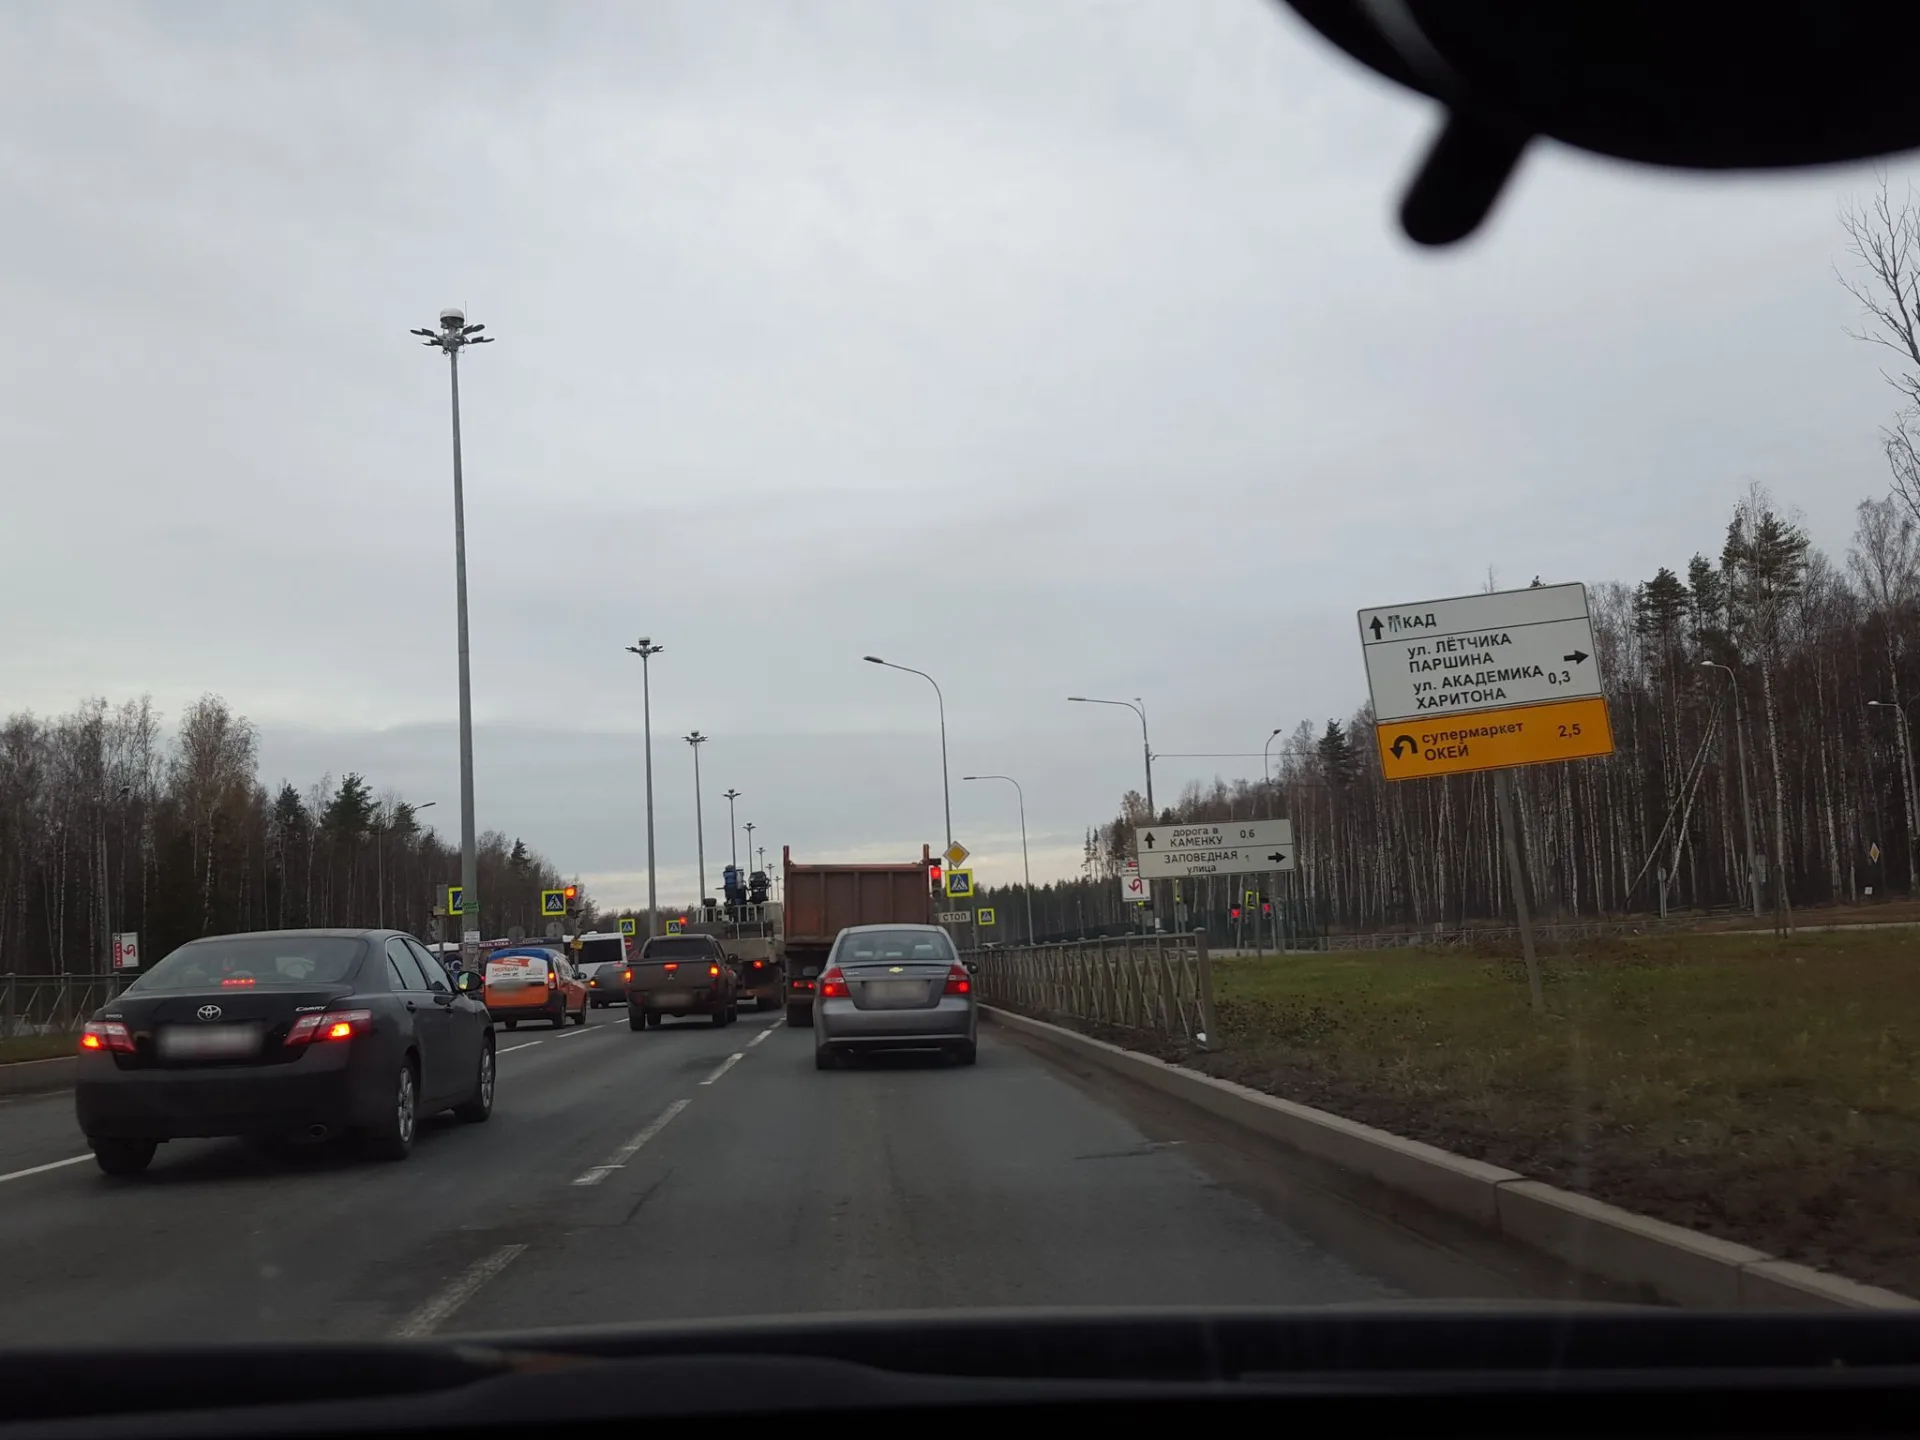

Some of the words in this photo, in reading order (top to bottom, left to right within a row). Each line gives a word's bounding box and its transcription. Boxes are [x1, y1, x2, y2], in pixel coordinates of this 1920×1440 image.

[1408, 646, 1431, 659] ул.
[1436, 633, 1512, 654] ЛЁТЧИКА
[1409, 652, 1494, 673] ПАРШИНА
[1413, 681, 1437, 695] ул.
[1442, 665, 1544, 690] АКАДЕМИКА
[1548, 671, 1571, 685] 0,3
[1416, 688, 1507, 710] ХАРИТОНА
[1422, 723, 1524, 745] супермаркет
[1558, 724, 1581, 738] 2,5
[1424, 742, 1469, 761] ОКЕЙ
[1173, 828, 1209, 838] дорога
[1212, 827, 1219, 835] в
[1170, 836, 1223, 848] КАМЕНКУ
[1164, 851, 1238, 864] ЗАПОВЕДНАЯ
[1186, 864, 1217, 875] улица
[943, 912, 966, 921] СТОП
